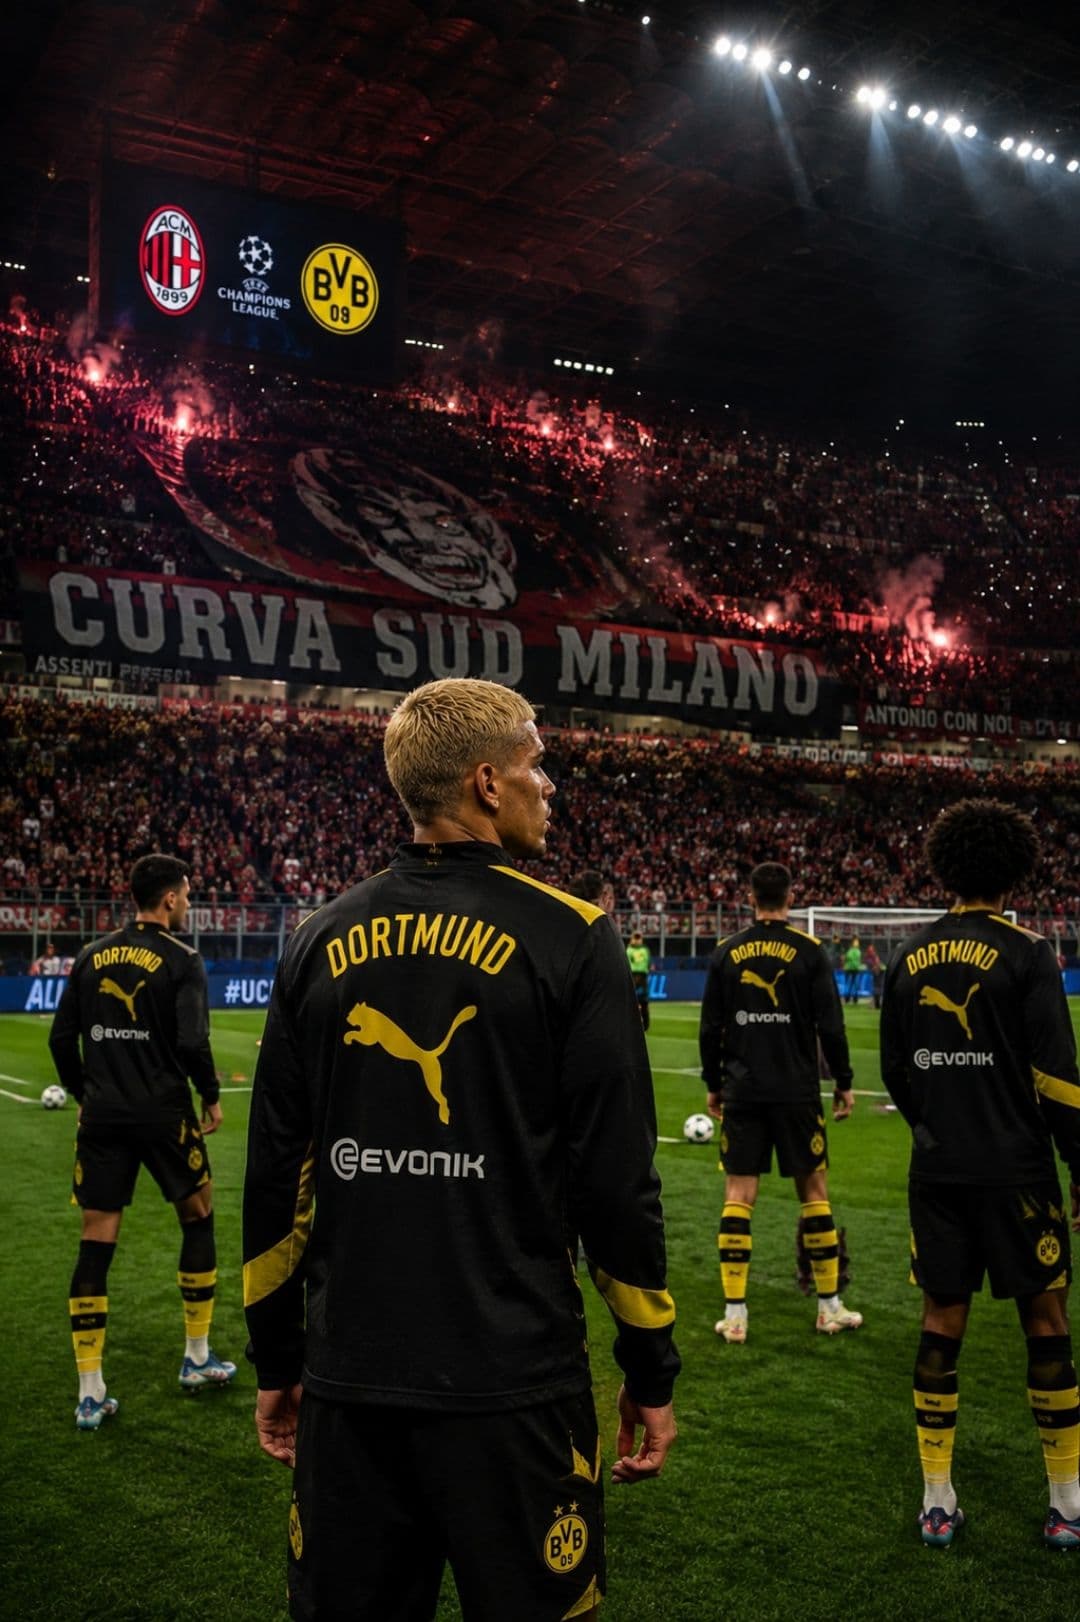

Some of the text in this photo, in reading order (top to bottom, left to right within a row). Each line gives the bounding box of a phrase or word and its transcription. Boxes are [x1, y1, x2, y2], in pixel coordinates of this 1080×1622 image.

[155, 214, 192, 238] ACM
[313, 253, 369, 308] BVB
[156, 286, 188, 303] 1899
[217, 287, 291, 309] CHAMPIONS
[330, 304, 350, 324] 09
[49, 571, 819, 717] CURVA SUD MILANO
[35, 655, 112, 678] ASSENTI
[865, 705, 937, 729] ANTONIO
[943, 711, 977, 733] CON
[93, 946, 163, 973] DORTMUND
[326, 913, 516, 979] DORTMUND
[730, 940, 797, 964] DORTMUND
[906, 940, 999, 976] DORTMUND
[930, 1051, 994, 1067] EVONIK
[361, 1148, 486, 1179] EVONIK
[550, 1520, 583, 1559] BVB
